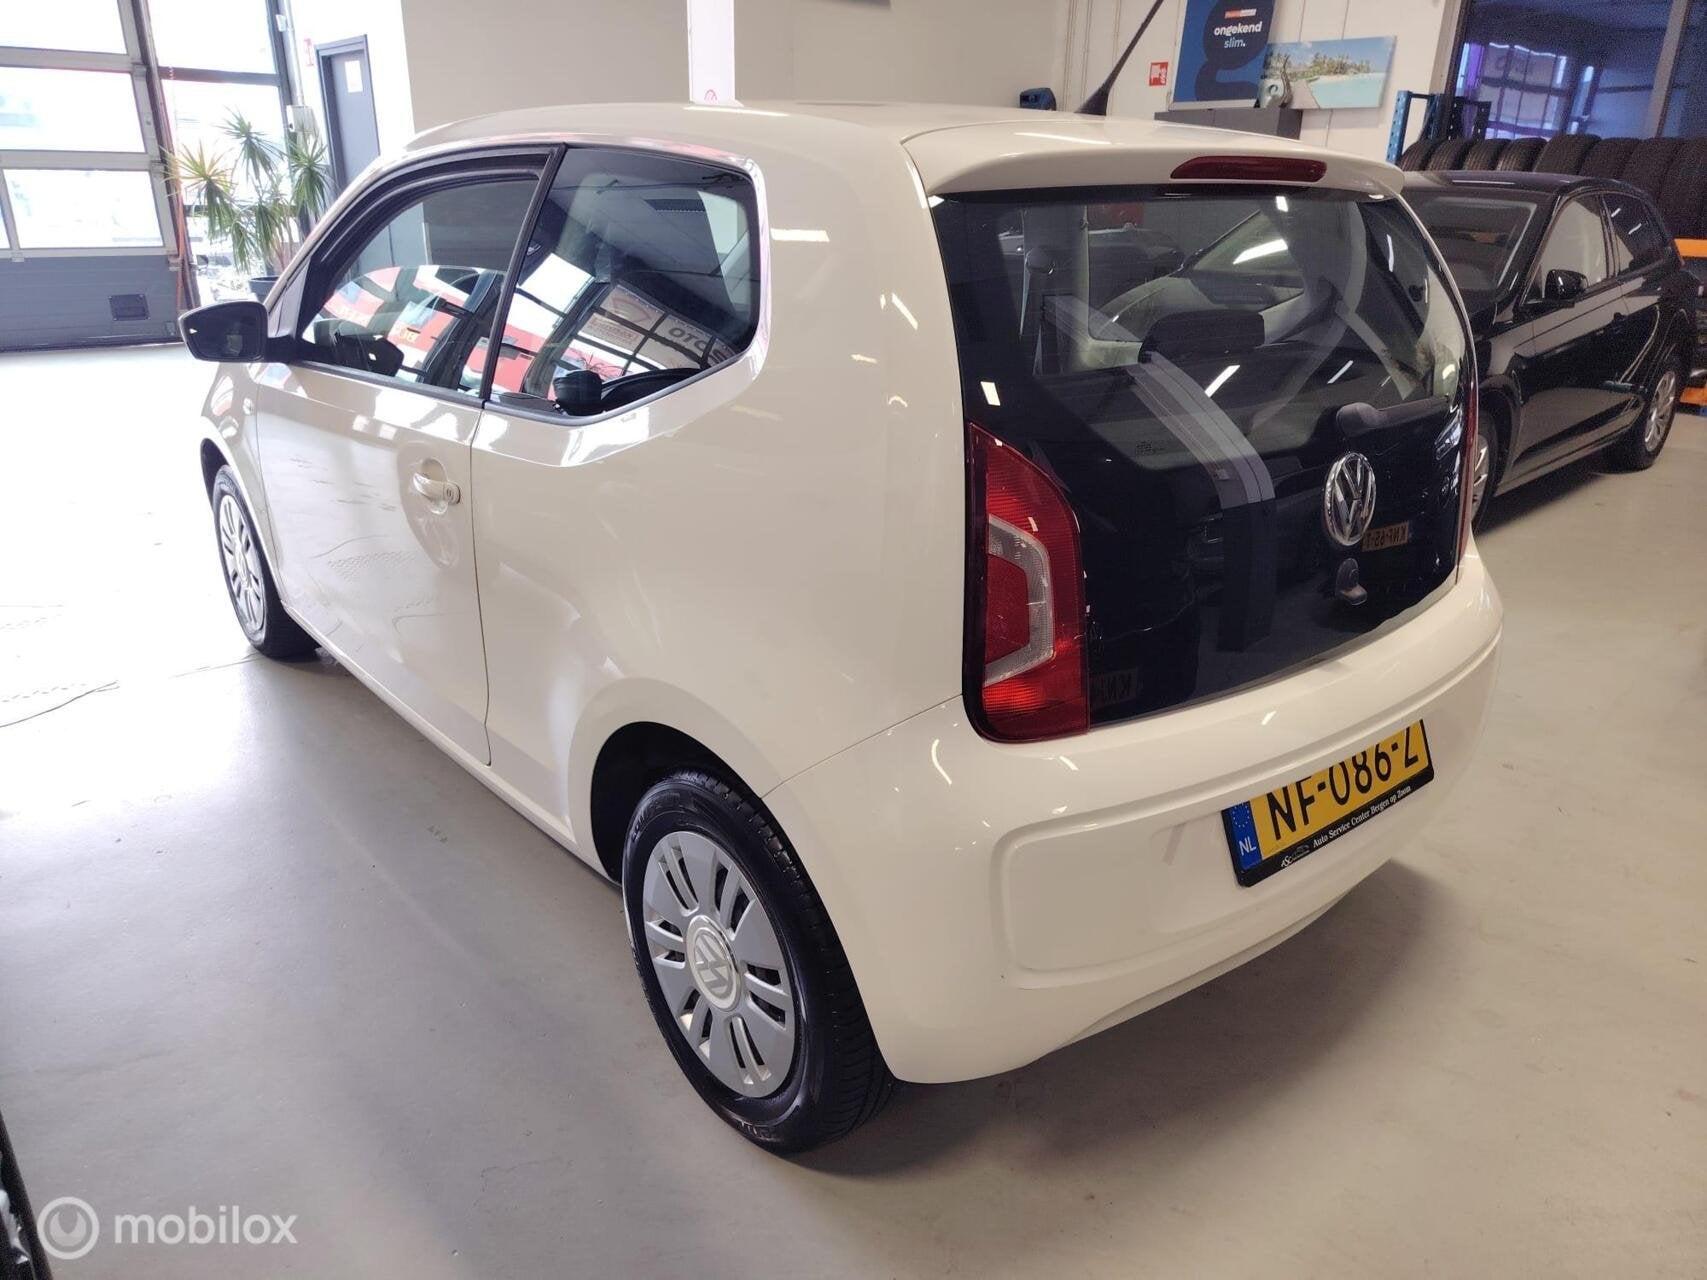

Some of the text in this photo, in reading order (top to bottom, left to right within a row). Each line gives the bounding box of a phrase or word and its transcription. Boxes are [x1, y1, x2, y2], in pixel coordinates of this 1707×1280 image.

[1214, 21, 1262, 36] ongekend
[1224, 36, 1246, 48] slim.
[1313, 835, 1328, 848] Auto
[1328, 821, 1351, 838] Service
[1350, 809, 1370, 826] Center
[1370, 800, 1390, 815] Bergen
[1389, 794, 1397, 804] op
[1397, 785, 1411, 799] Zoom
[1239, 837, 1257, 856] NL
